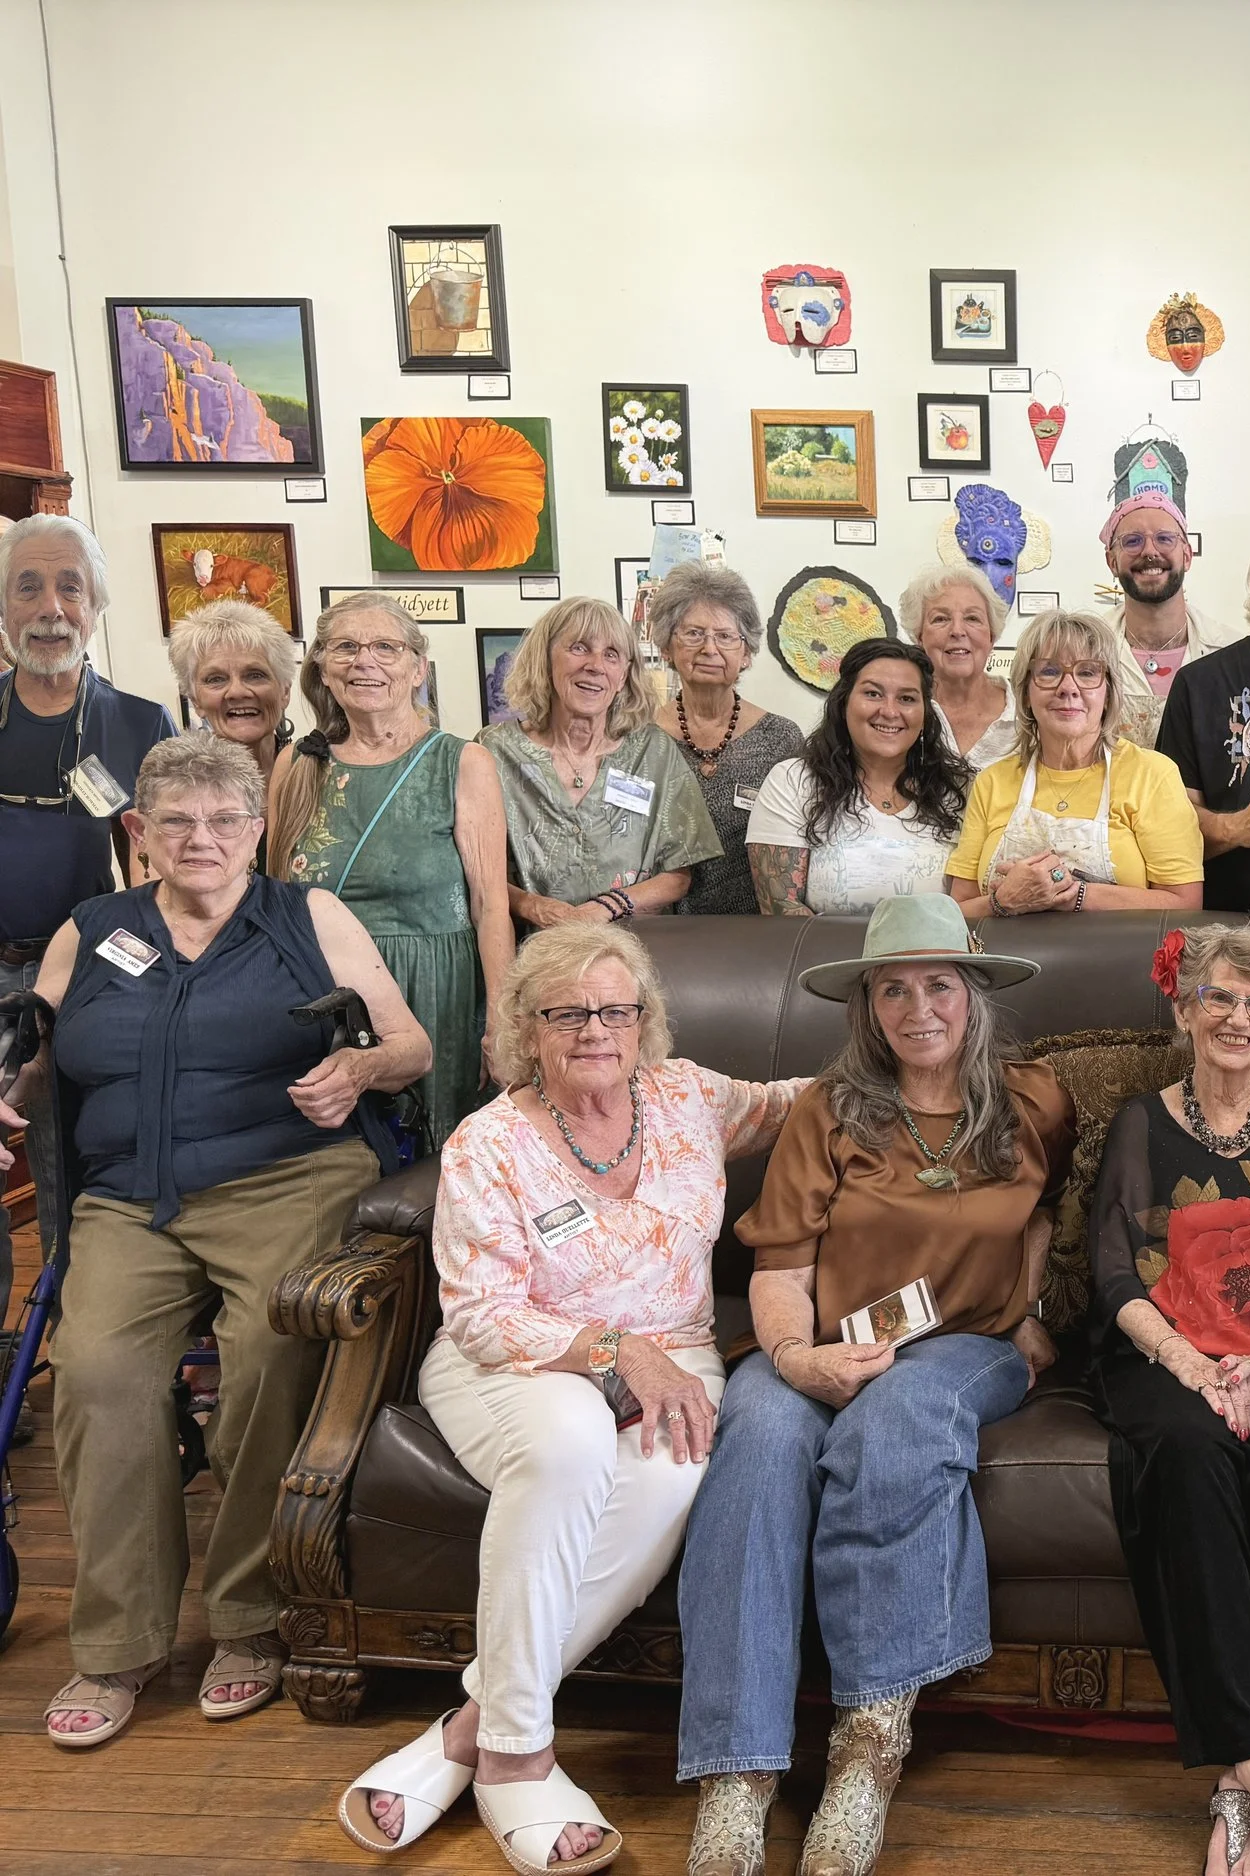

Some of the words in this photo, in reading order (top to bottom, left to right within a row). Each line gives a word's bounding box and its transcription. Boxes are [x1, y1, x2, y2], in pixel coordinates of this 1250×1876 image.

[1137, 484, 1165, 494] HOME
[396, 593, 449, 617] idyett
[107, 946, 127, 961] VIRGINIA
[127, 960, 140, 969] AMES
[546, 1231, 562, 1241] LINDA
[561, 1217, 590, 1234] OUELLETTE
